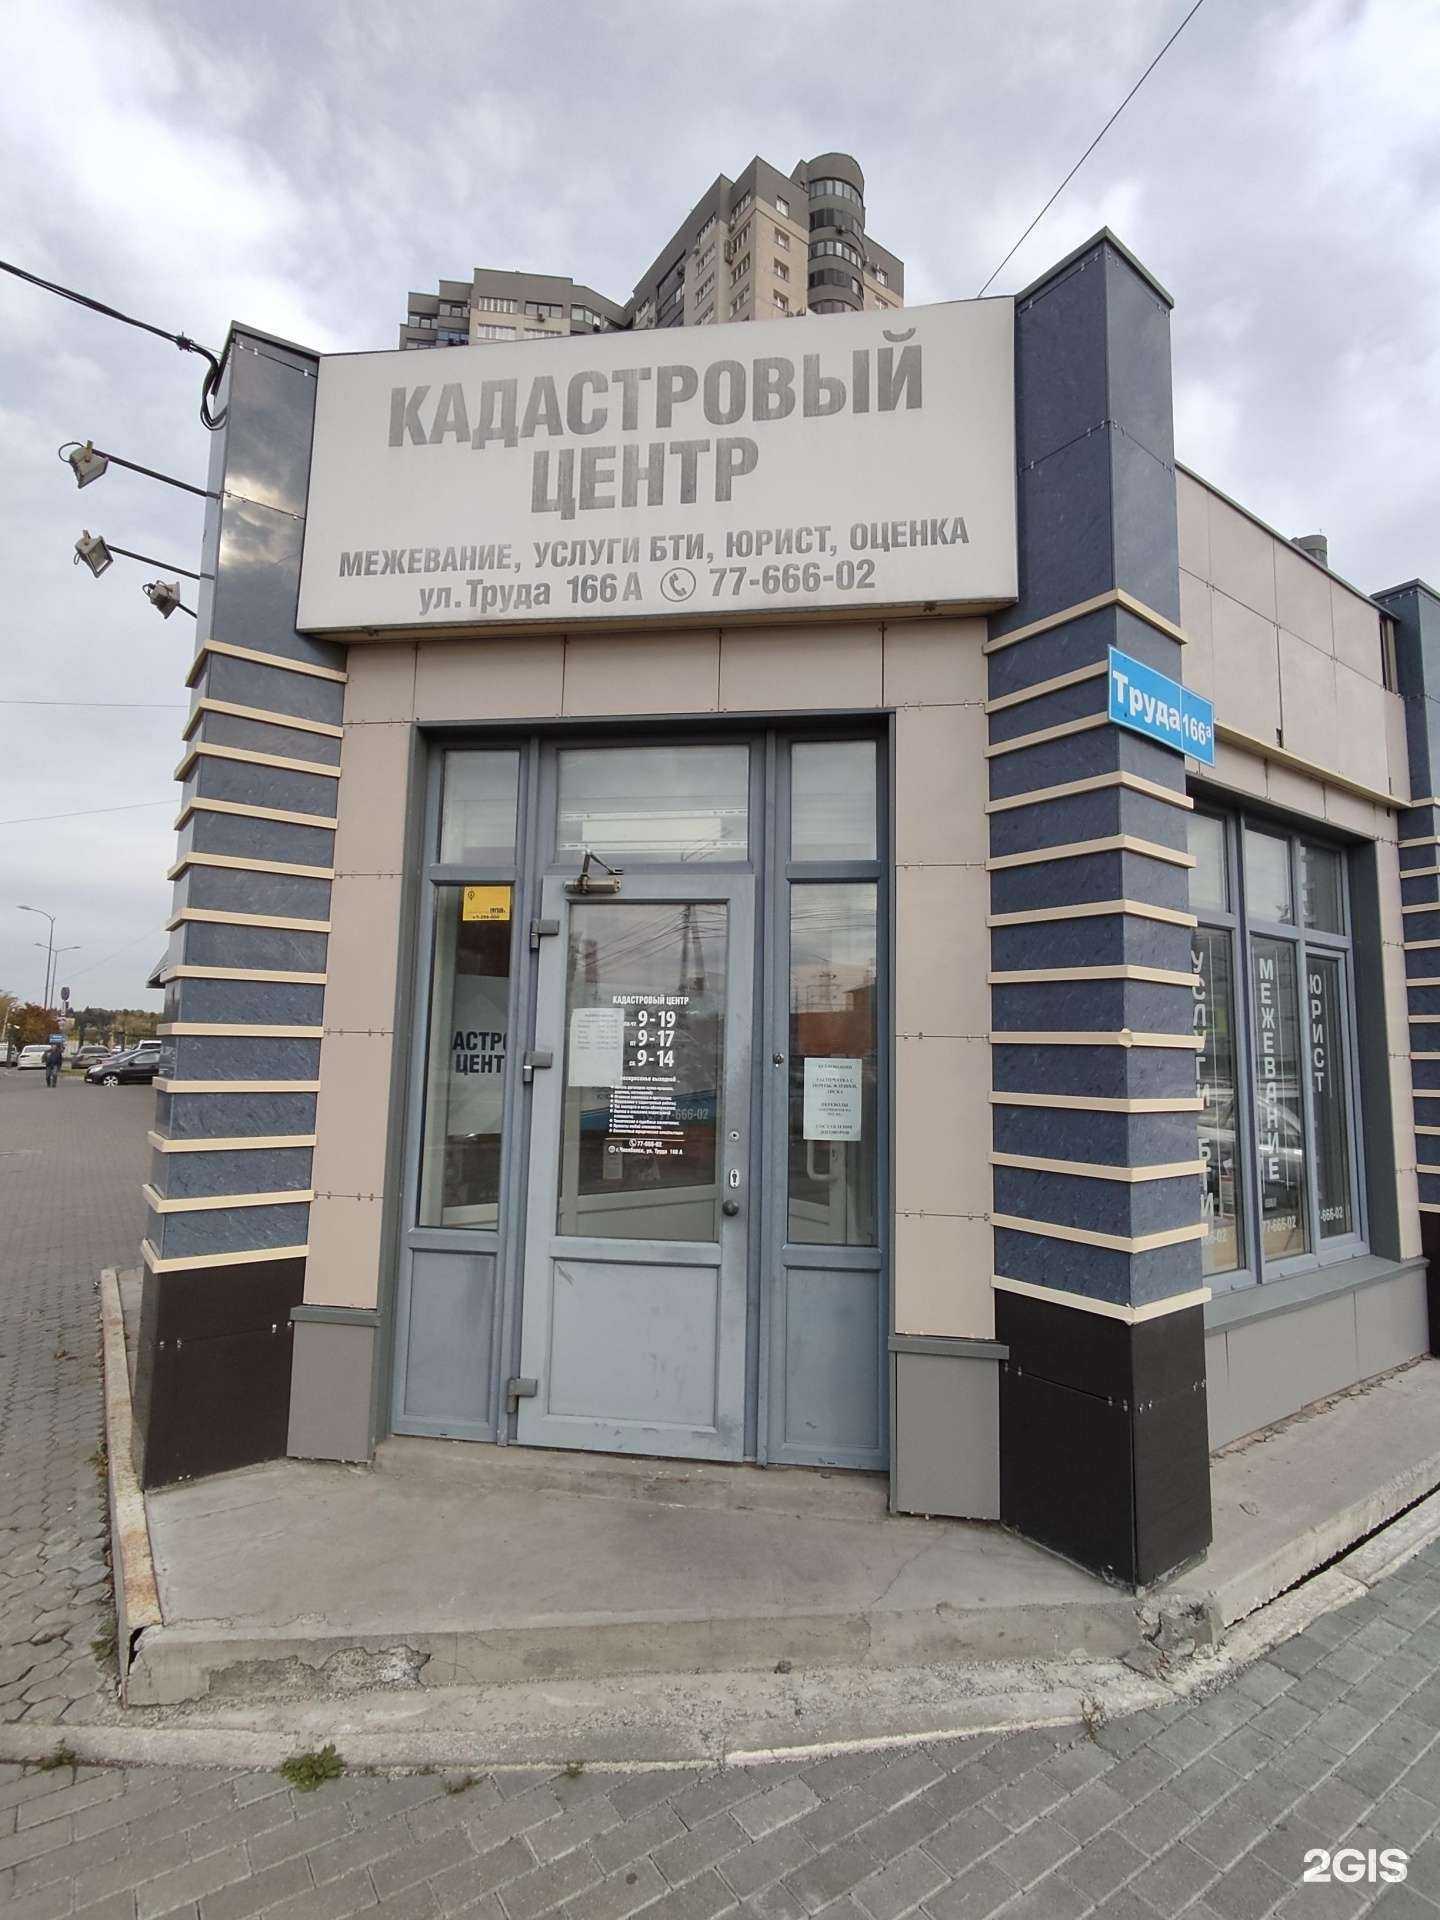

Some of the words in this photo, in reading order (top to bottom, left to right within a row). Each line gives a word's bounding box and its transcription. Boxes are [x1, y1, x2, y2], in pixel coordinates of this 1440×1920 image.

[388, 328, 922, 450] КАДАСТРОВЫЙ
[531, 437, 759, 520] ЦЕНТР
[339, 544, 521, 577] МЕЖЕВАНИЕ,
[533, 537, 640, 568] УСЛУГИ
[650, 533, 714, 563] БТИ,
[726, 525, 837, 557] ЮРИСТ,
[850, 516, 969, 552] ОЦЕНКА
[709, 559, 876, 597] 77-666-02
[1112, 670, 1181, 731] Труда
[612, 994, 665, 1005] КАДАСТРОВЫЙ
[666, 996, 689, 1006] ЦЕНТР
[452, 1031, 506, 1050] АСТР
[1309, 973, 1325, 1092] ЮРИСТ
[1259, 958, 1279, 1180] МЕЖЕВАНИЕ
